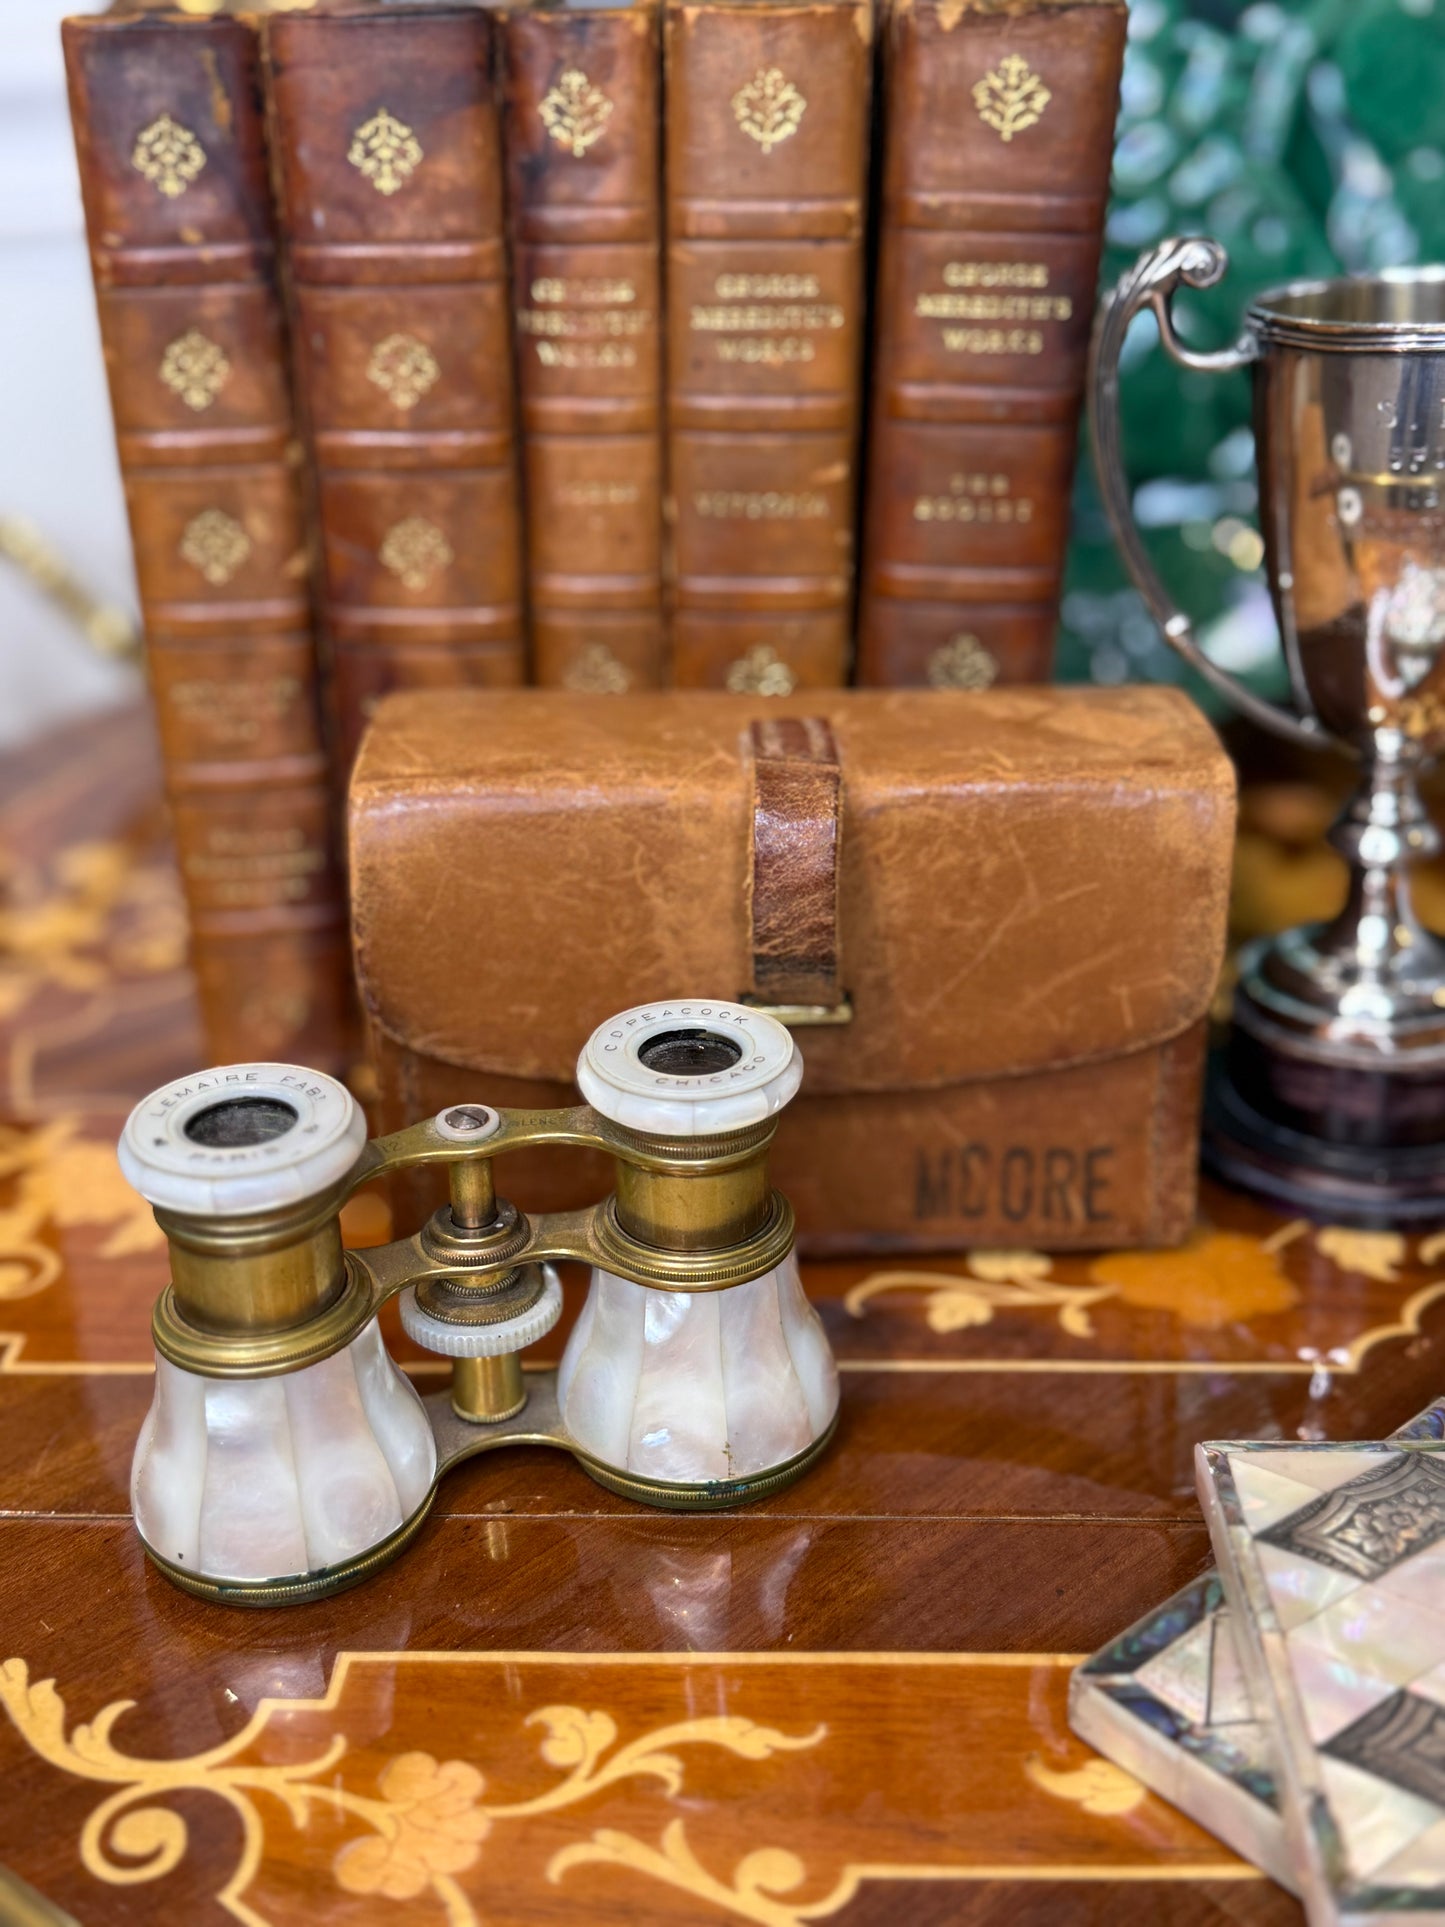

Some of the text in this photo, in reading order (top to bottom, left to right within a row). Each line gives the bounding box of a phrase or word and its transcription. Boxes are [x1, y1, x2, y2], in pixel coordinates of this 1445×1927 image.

[714, 273, 820, 298] GEORGE
[942, 263, 1048, 288] GEORGE
[626, 1007, 750, 1028] PEACOCK
[150, 1072, 259, 1118] LEMAIRE
